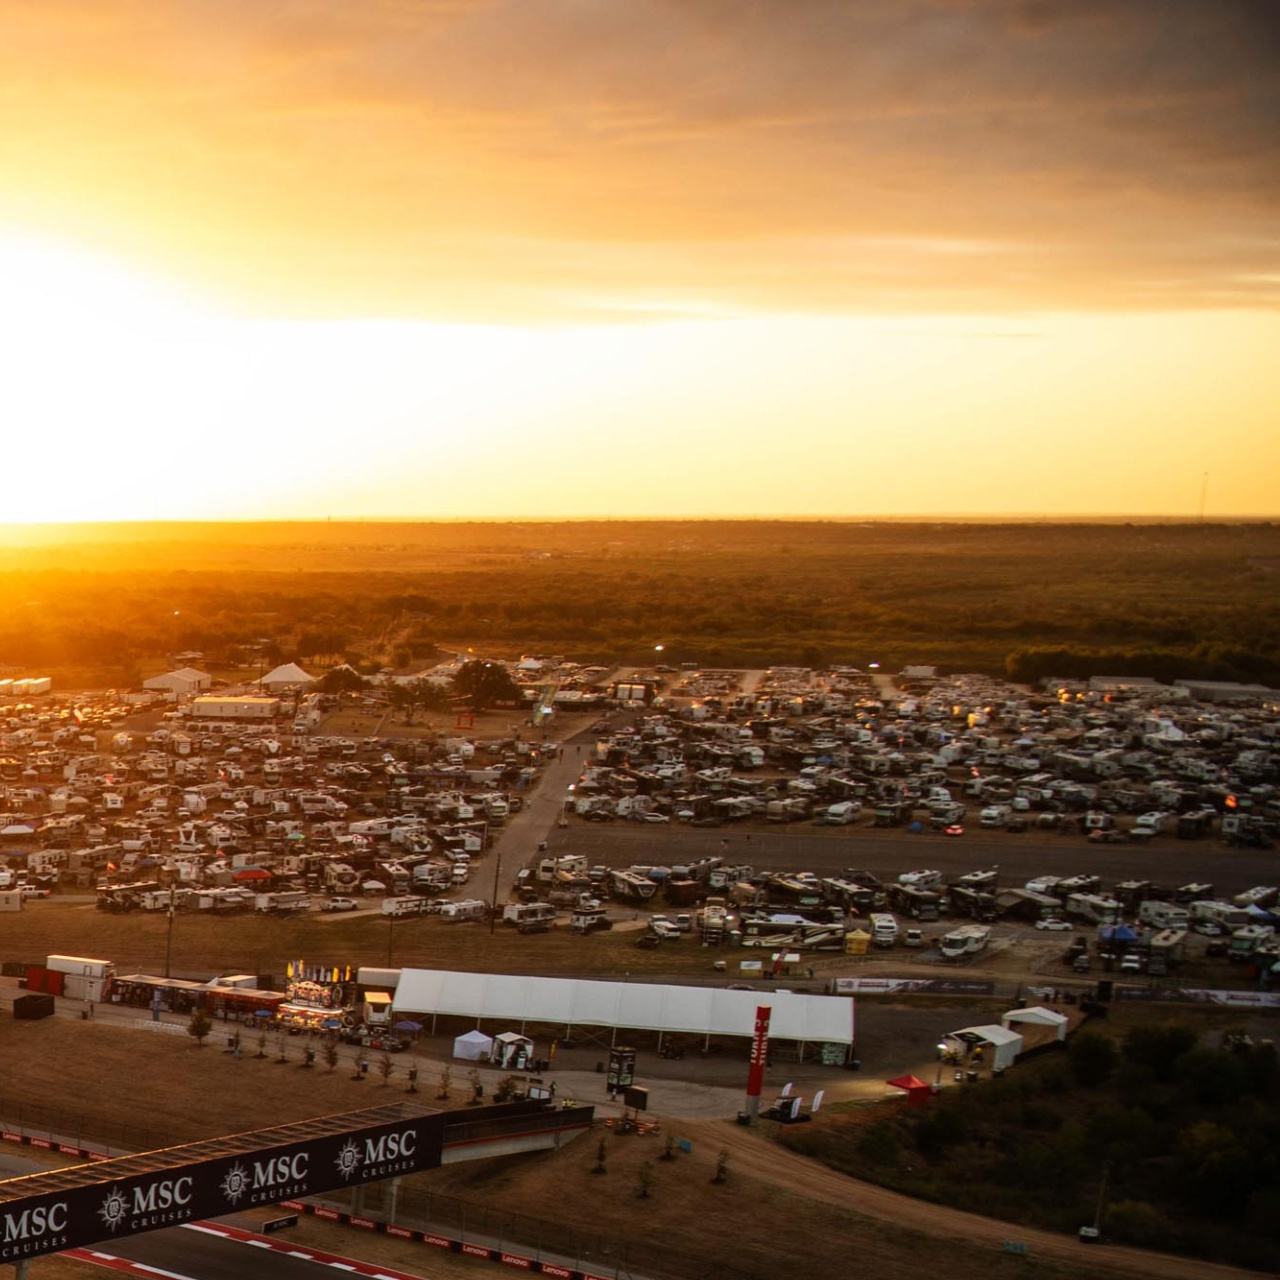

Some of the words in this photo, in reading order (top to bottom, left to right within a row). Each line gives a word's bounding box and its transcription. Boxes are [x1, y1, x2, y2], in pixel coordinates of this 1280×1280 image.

[3, 1132, 22, 1142] Lenovo
[31, 1138, 49, 1148] Lenovo
[60, 1145, 79, 1155] Lenovo
[363, 1129, 417, 1166] MSC
[251, 1152, 310, 1189] MSC
[362, 1158, 416, 1178] CRUISES
[131, 1176, 193, 1215] MSC
[251, 1183, 309, 1204] CRUISES
[131, 1207, 193, 1230] CRUISES
[314, 1207, 338, 1219] Lenovo
[2, 1202, 68, 1242] MSC
[350, 1217, 374, 1228] Lenovo
[387, 1226, 411, 1238] Lenovo
[2, 1234, 68, 1257] CRUISES
[424, 1235, 449, 1246] Lenovo
[463, 1244, 488, 1257] Lenovo
[502, 1254, 528, 1267] Lenovo
[543, 1262, 569, 1277] Lenovo
